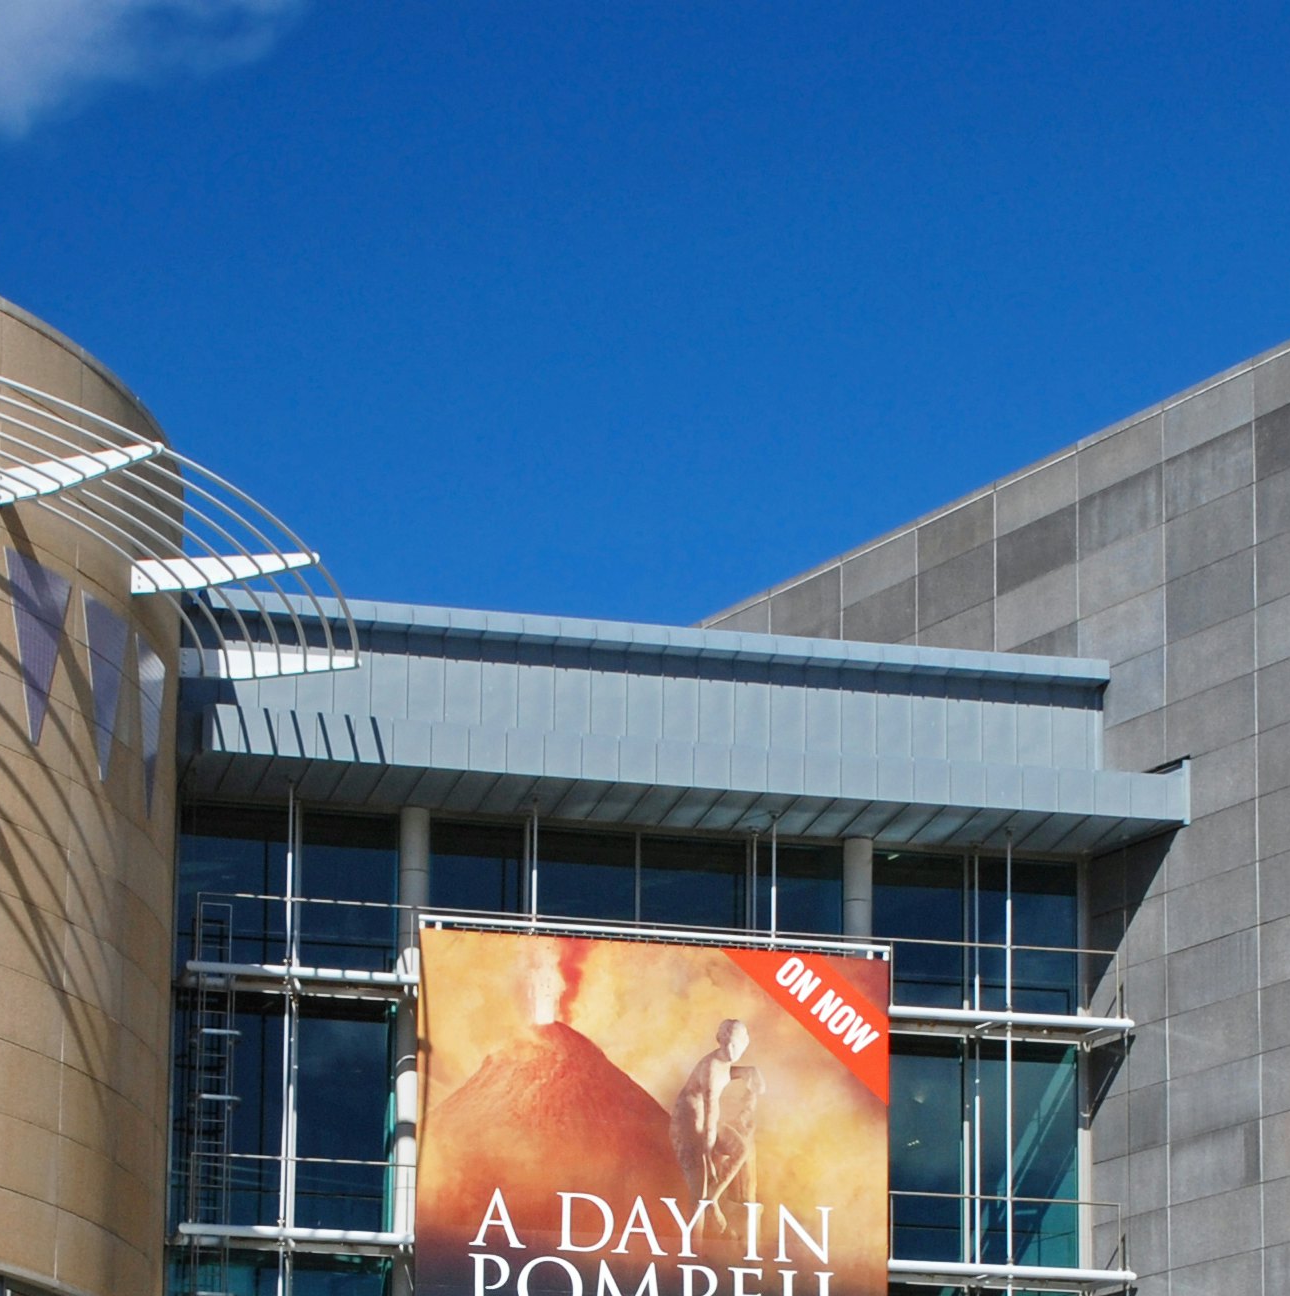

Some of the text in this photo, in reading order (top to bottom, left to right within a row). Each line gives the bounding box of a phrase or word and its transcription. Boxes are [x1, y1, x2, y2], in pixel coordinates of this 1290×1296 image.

[775, 956, 880, 1054] ON NOW
[468, 1187, 834, 1266] A DAY IN
